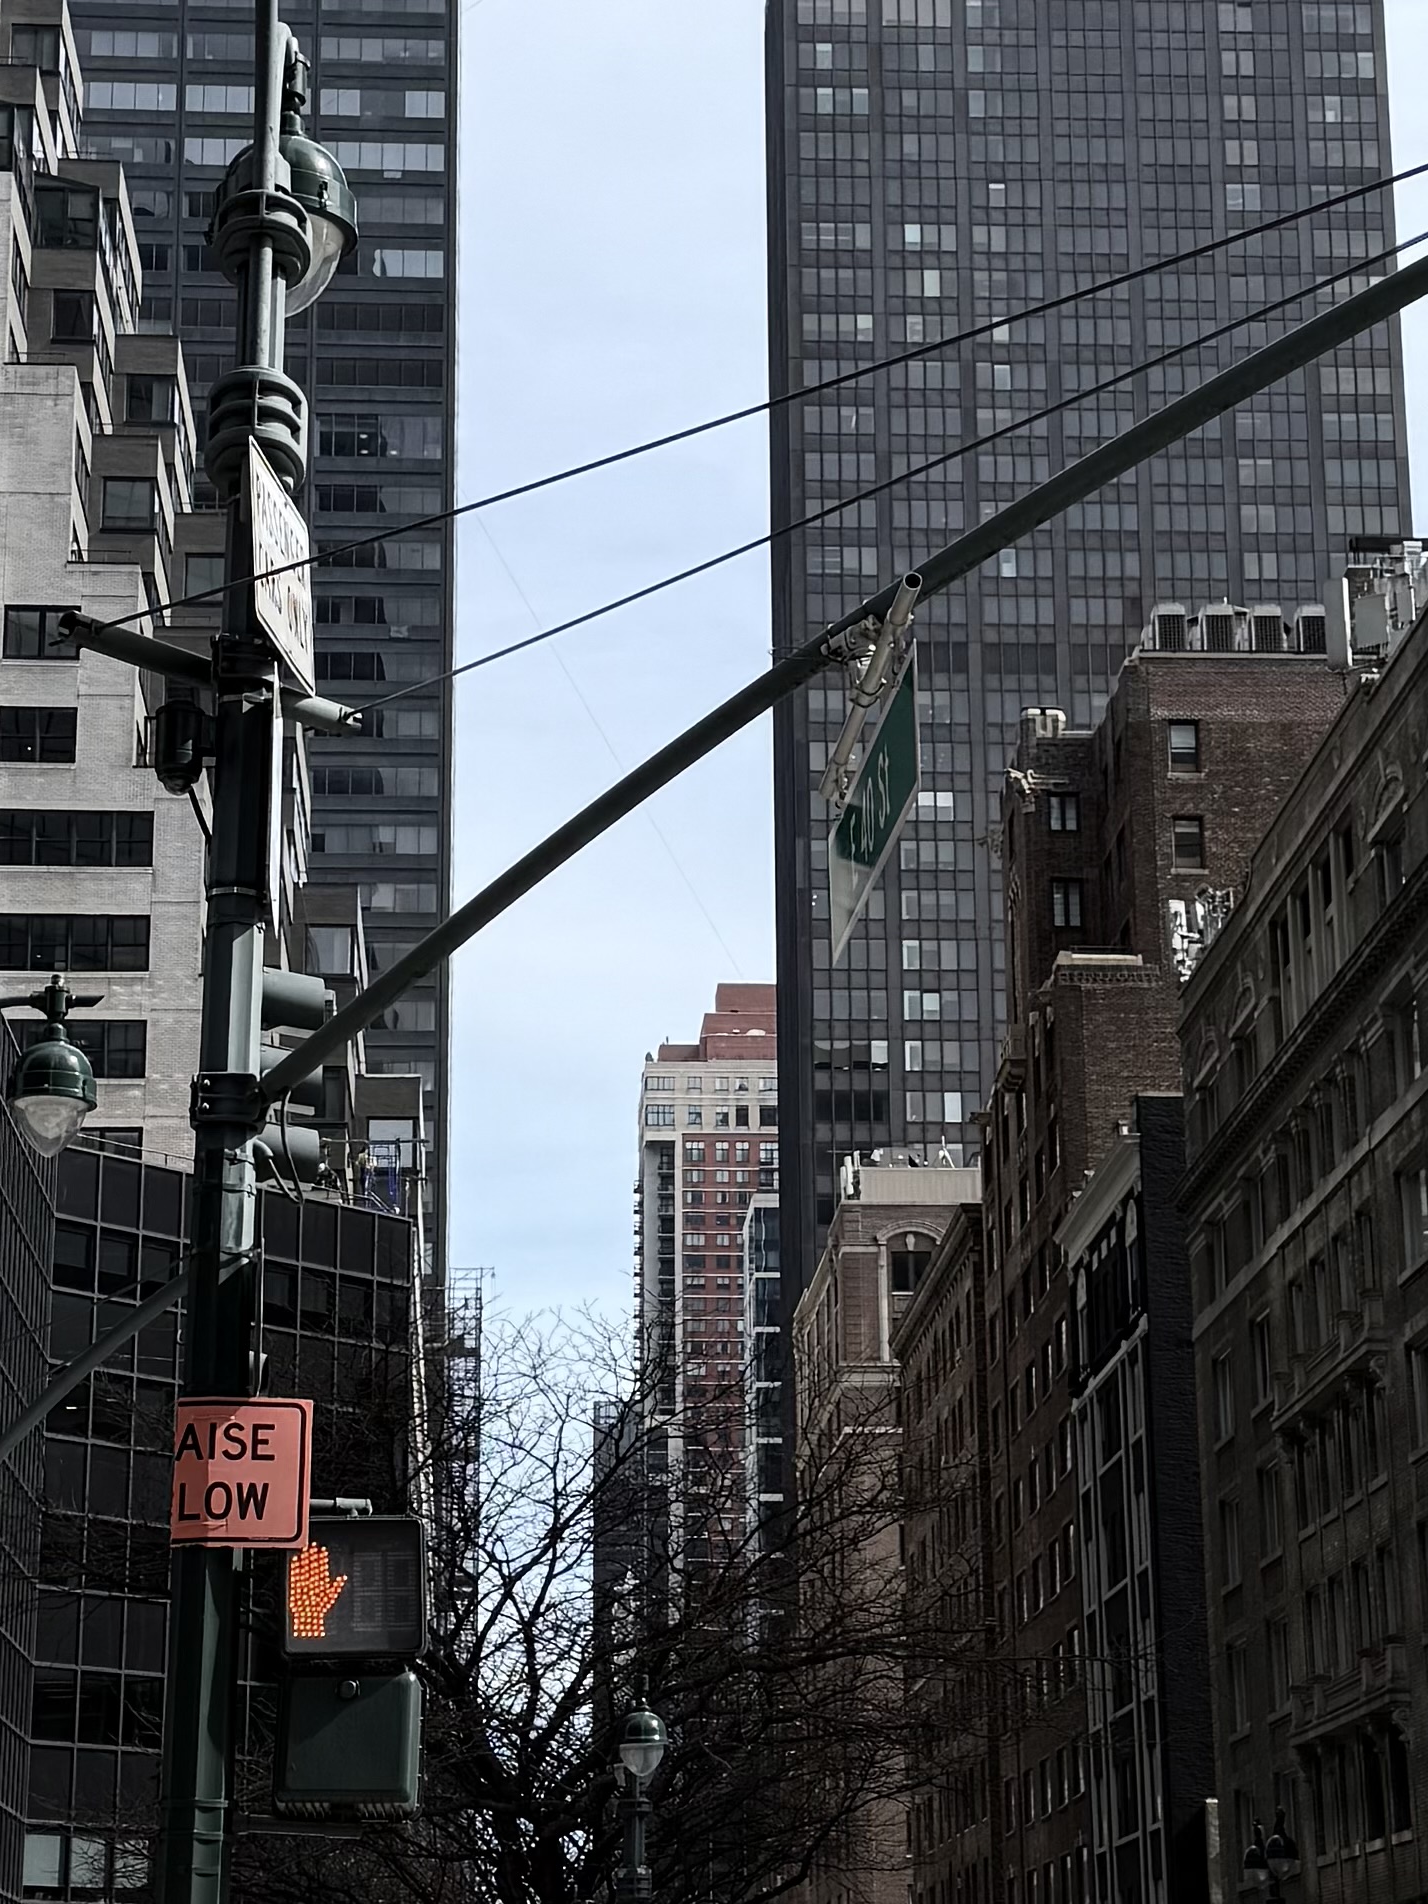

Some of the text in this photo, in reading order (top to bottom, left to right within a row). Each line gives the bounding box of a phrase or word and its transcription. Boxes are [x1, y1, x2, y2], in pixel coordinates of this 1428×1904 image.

[860, 776, 874, 863] 40
[877, 740, 890, 830] St
[177, 1482, 270, 1523] LOW
